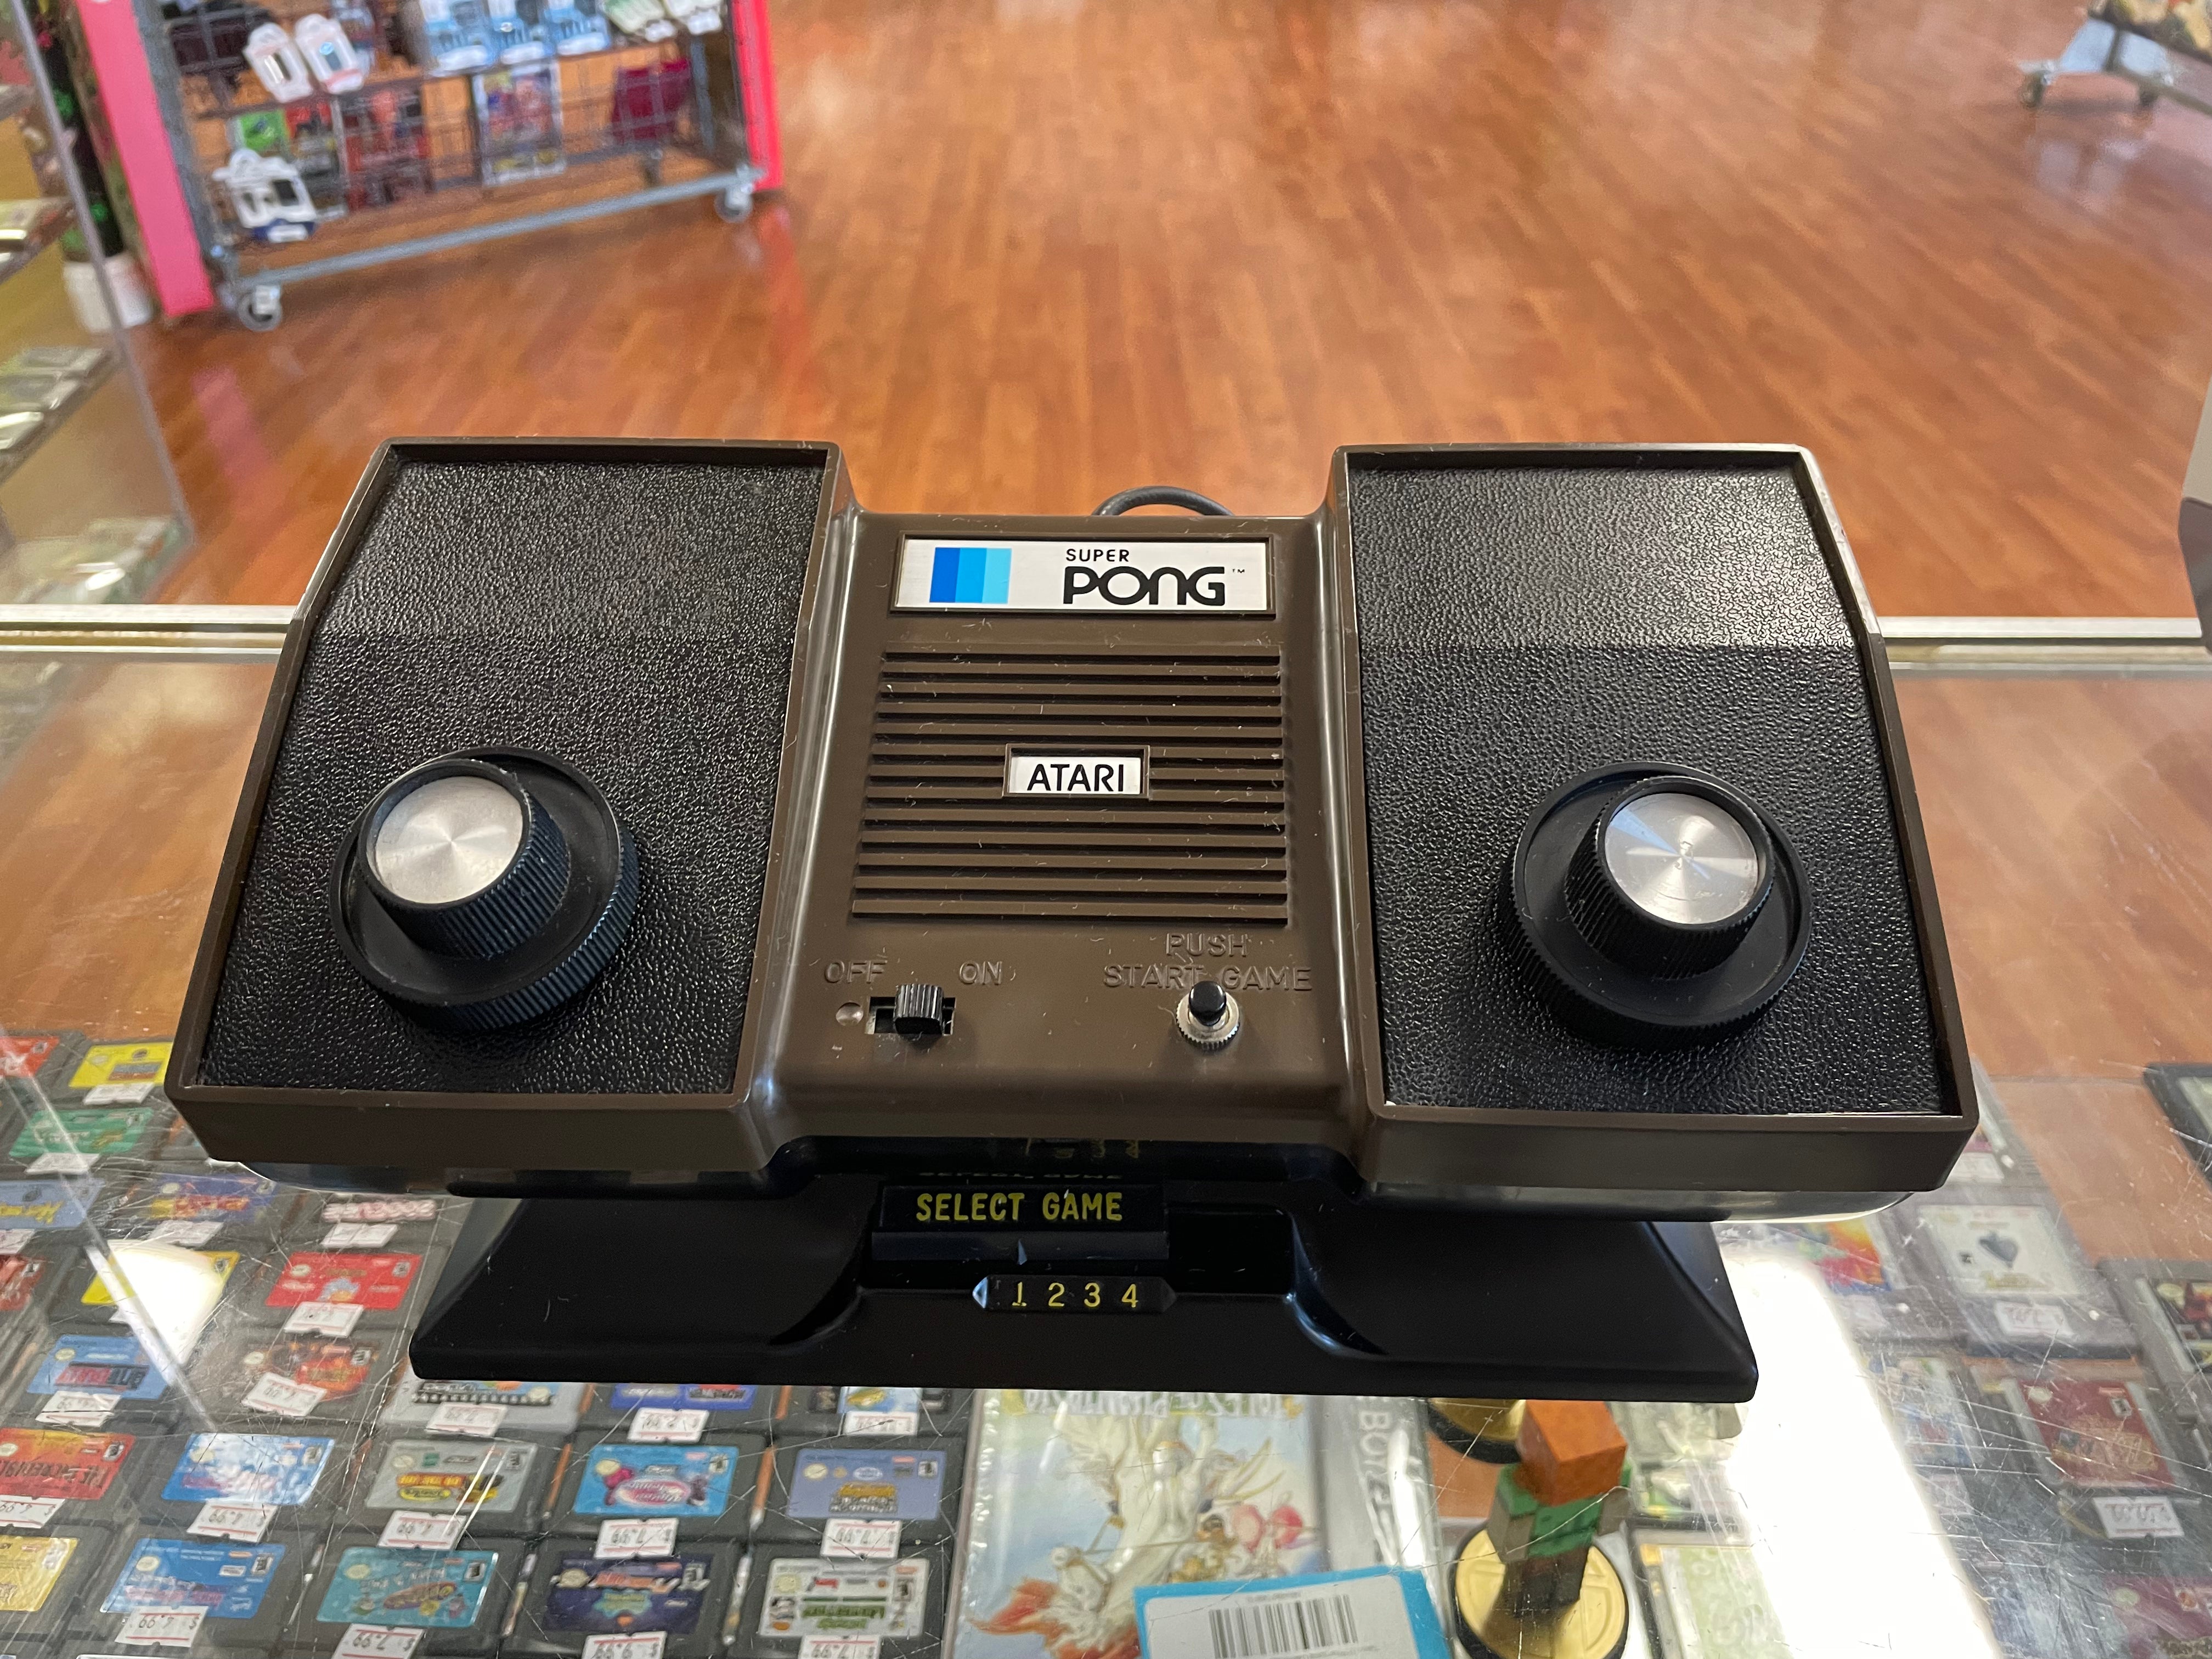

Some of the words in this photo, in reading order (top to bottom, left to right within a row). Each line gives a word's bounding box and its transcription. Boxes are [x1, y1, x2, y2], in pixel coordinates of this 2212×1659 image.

[1065, 548, 1130, 563] SUPER
[1063, 566, 1226, 606] PONG
[1026, 762, 1125, 792] ATARI
[1165, 932, 1249, 958] PUSH
[823, 959, 885, 984] OFF
[959, 960, 1003, 985] ON
[1103, 963, 1207, 990] START
[1220, 967, 1313, 992] GAME
[916, 1193, 1025, 1222] SELECT
[1042, 1191, 1123, 1221] GAME
[1011, 1282, 1027, 1307] 1
[1048, 1282, 1066, 1308] 2
[1084, 1282, 1101, 1307] 3
[1121, 1283, 1139, 1308] 4
